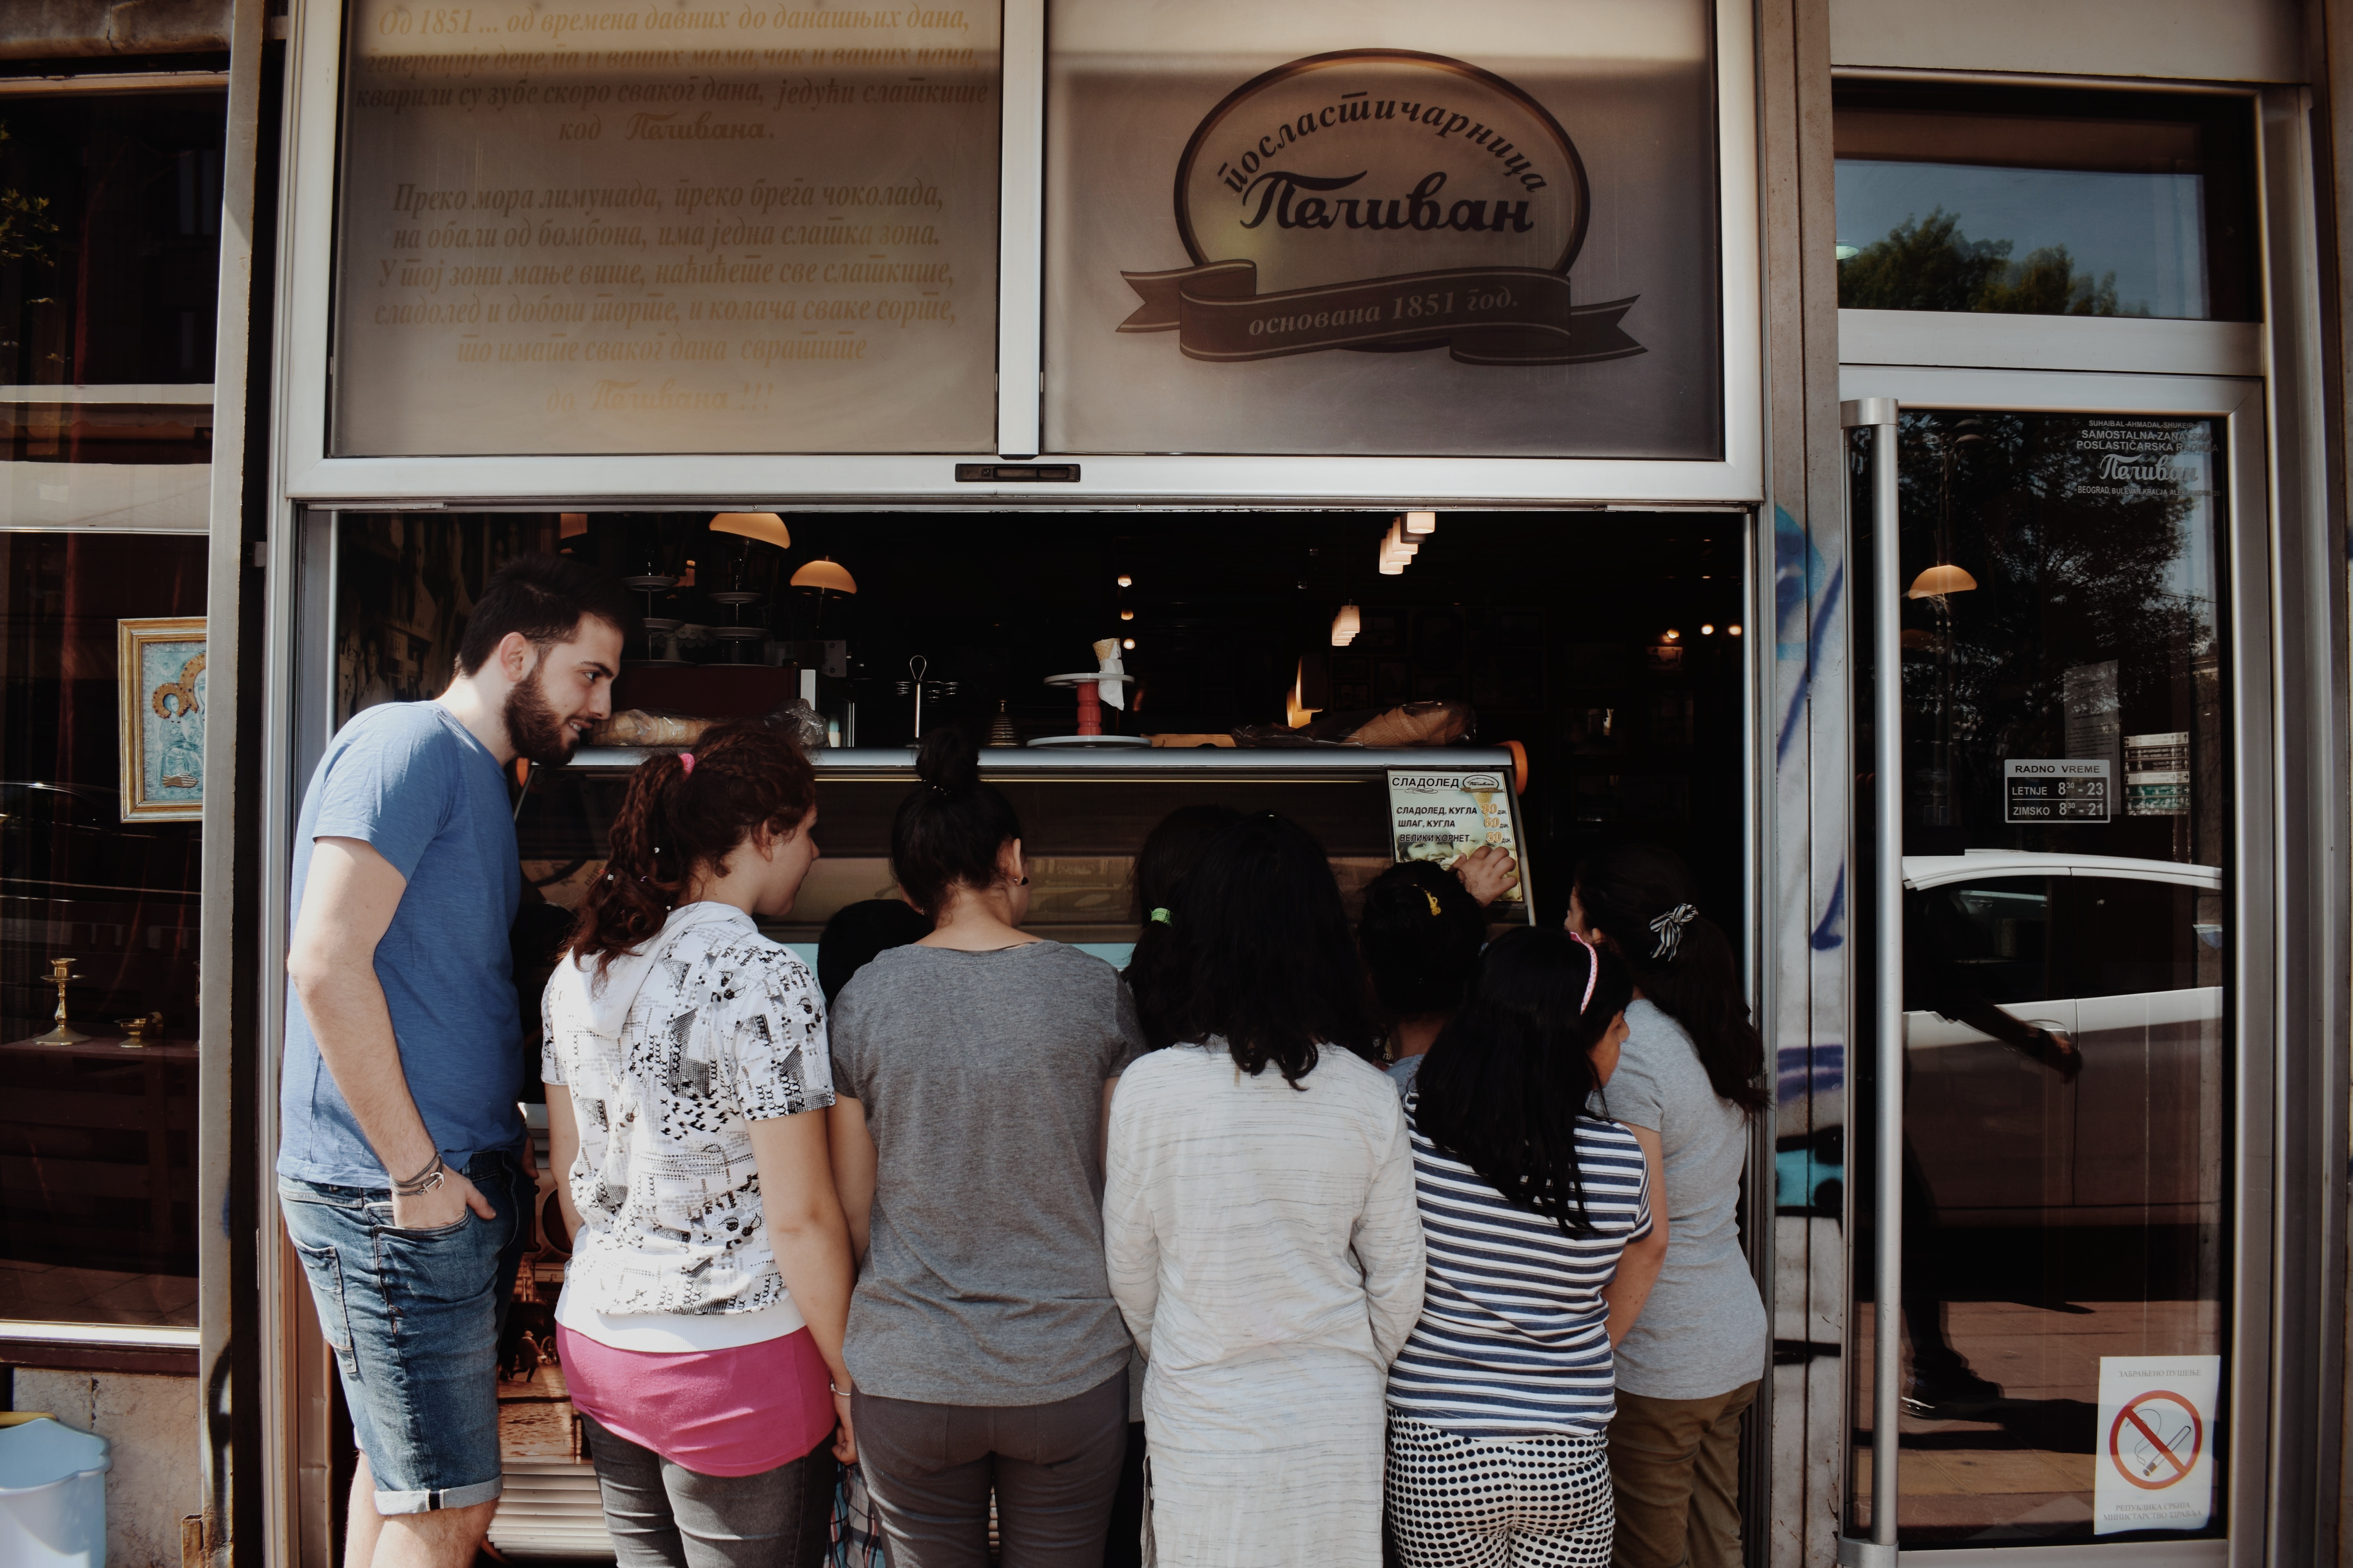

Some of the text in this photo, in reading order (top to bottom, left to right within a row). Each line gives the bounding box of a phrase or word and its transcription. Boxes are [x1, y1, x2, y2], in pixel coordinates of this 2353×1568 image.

[379, 9, 413, 35] Од
[508, 7, 535, 33] од
[541, 11, 638, 39] времена
[645, 4, 728, 29] давних
[739, 3, 766, 29] до
[773, 3, 900, 29] данашњих
[907, 2, 969, 33] дана,
[606, 49, 683, 68] ваших
[832, 47, 910, 67] ваших
[356, 75, 988, 115] кварили су зубе скоро сваког дана, једући слаткише
[559, 114, 602, 141] код
[392, 177, 943, 219] Преко мора лимунада, преко брега чоколада,
[1239, 169, 1534, 234] Пеливан
[393, 216, 940, 254] на обали од бомбона, има једна слатка зона.
[378, 254, 954, 295] У тој зони мање више, наћићете све слаткише,
[373, 291, 956, 330] сладолед и добош торте, и колача сваке сорте,
[1248, 284, 1519, 338] основана 1851 год.
[457, 330, 867, 368] то имате сваког дана свратите
[545, 383, 576, 412] до
[2076, 440, 2173, 451] POSLASTIČARSKA
[2082, 430, 2154, 440] SAMOSTALNA
[2099, 454, 2199, 481] Пеливан
[2078, 486, 2111, 495] BEOGRAD,
[1392, 778, 1459, 788] СЛАДОЛЕД
[2012, 787, 2048, 795] LETNJE
[2087, 782, 2103, 795] 23
[1397, 807, 1447, 815] СЛАДОЛЕД,
[1482, 804, 1497, 814] 80
[2013, 807, 2050, 815] ZIMSKO
[2088, 803, 2103, 815] 21
[1398, 820, 1425, 828] ШЛАГ,
[1484, 817, 1500, 828] 60
[1486, 831, 1502, 843] 50
[2103, 1510, 2202, 1521] МИНИСТАРСТВО ЗДРАВЉА
[2164, 1502, 2190, 1510] СРБИЈА
